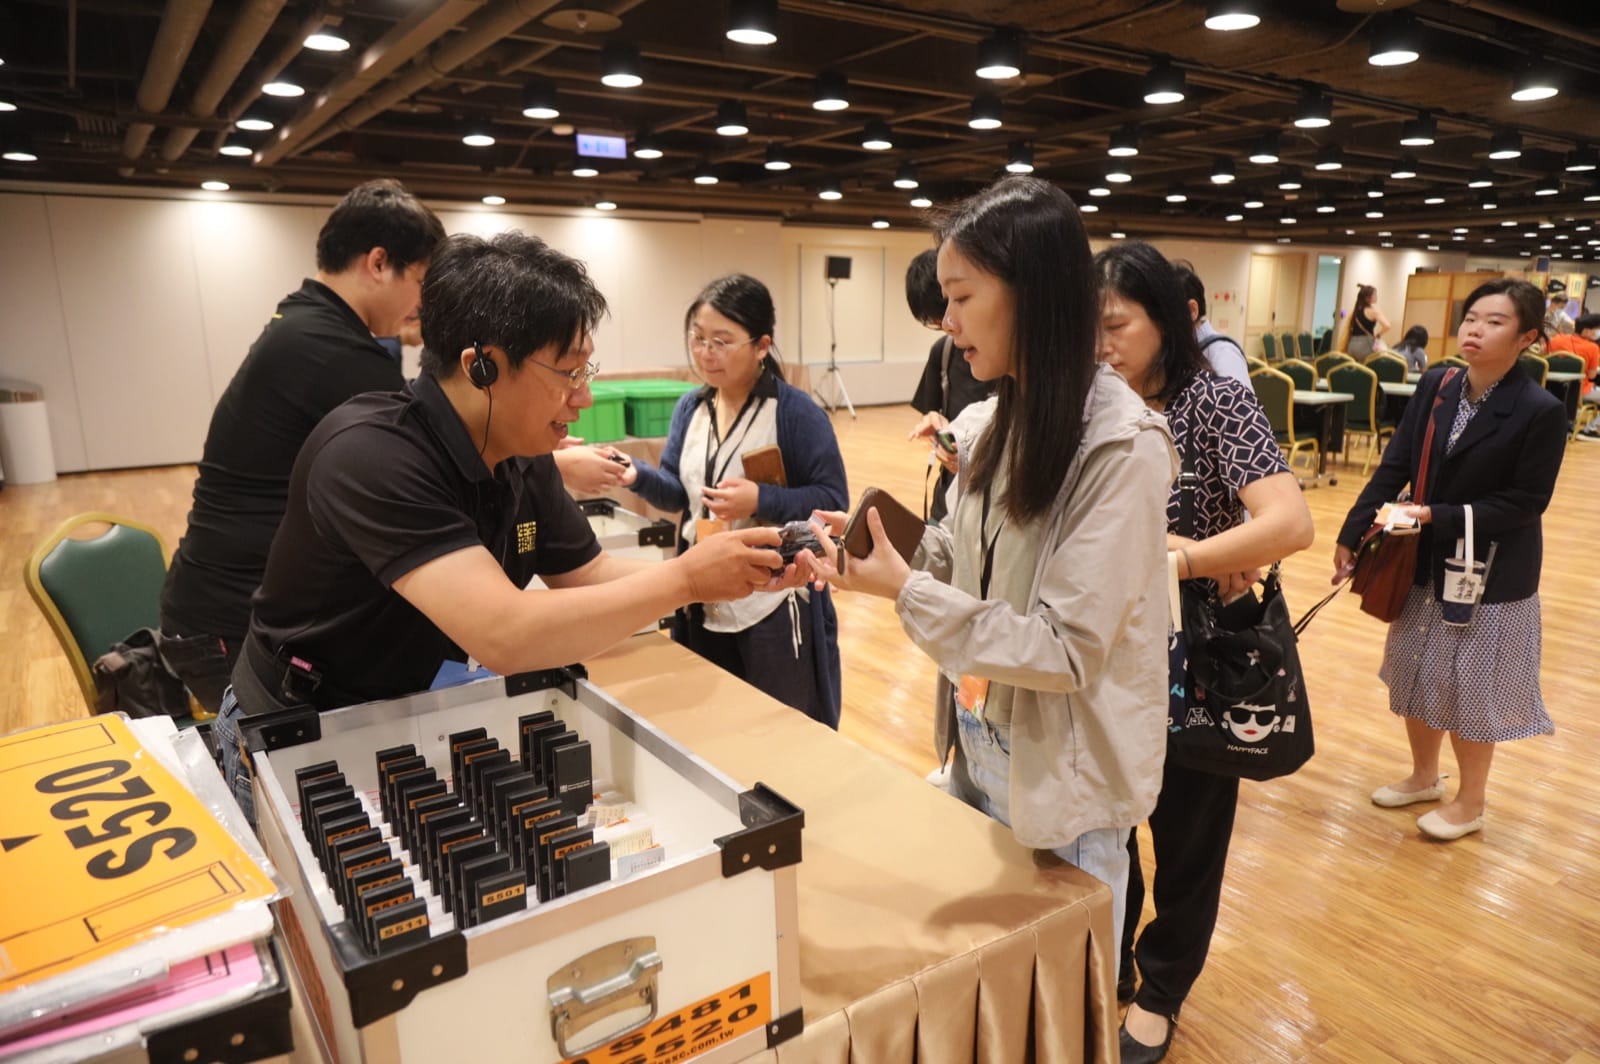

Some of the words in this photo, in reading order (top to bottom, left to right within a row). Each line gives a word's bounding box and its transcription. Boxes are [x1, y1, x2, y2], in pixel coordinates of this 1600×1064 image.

[35, 759, 197, 880] S520
[487, 887, 521, 903] S501
[384, 918, 423, 937] S511
[609, 984, 751, 1057] S481
